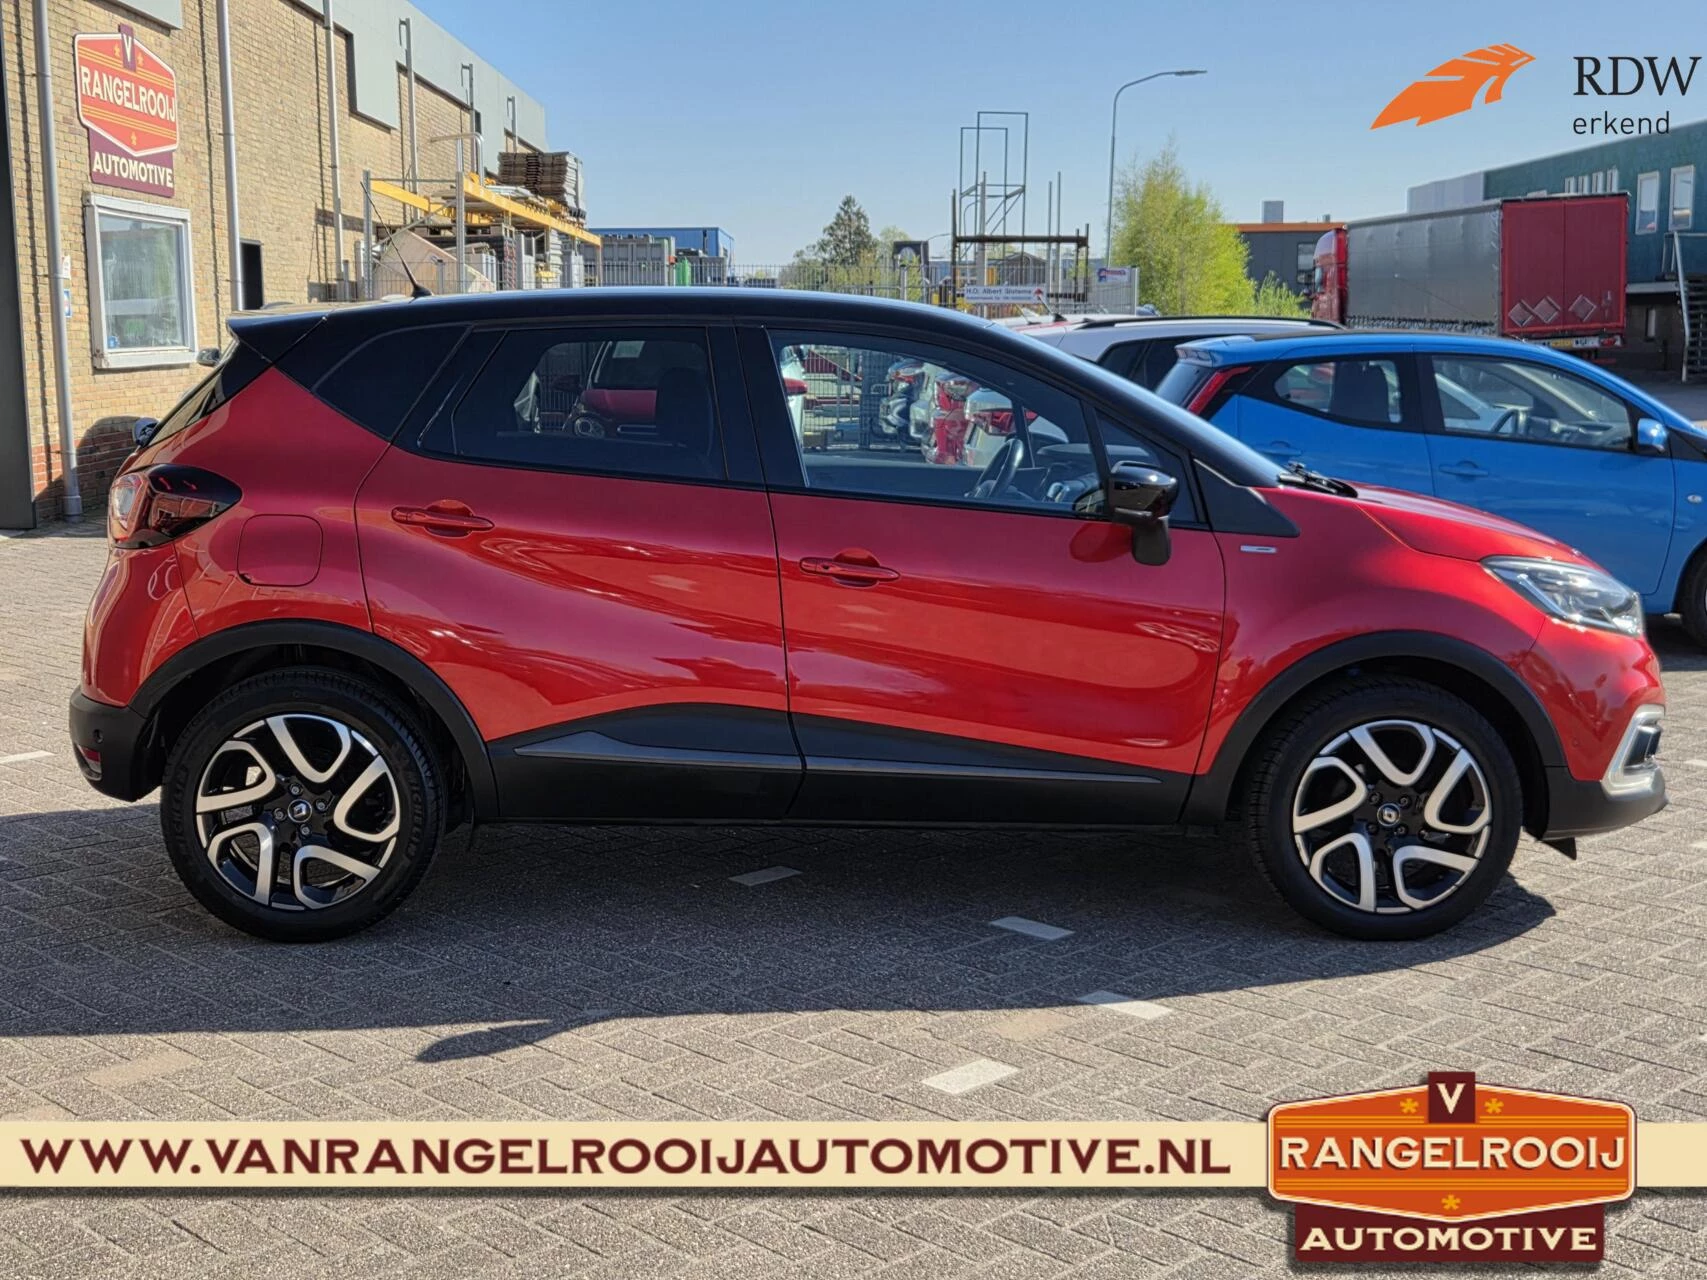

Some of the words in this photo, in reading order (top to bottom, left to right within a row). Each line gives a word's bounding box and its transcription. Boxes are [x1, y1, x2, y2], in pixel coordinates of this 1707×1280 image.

[123, 34, 132, 62] V
[80, 66, 176, 122] RANGELROOIJ
[92, 151, 174, 188] AUTOMOTIVE
